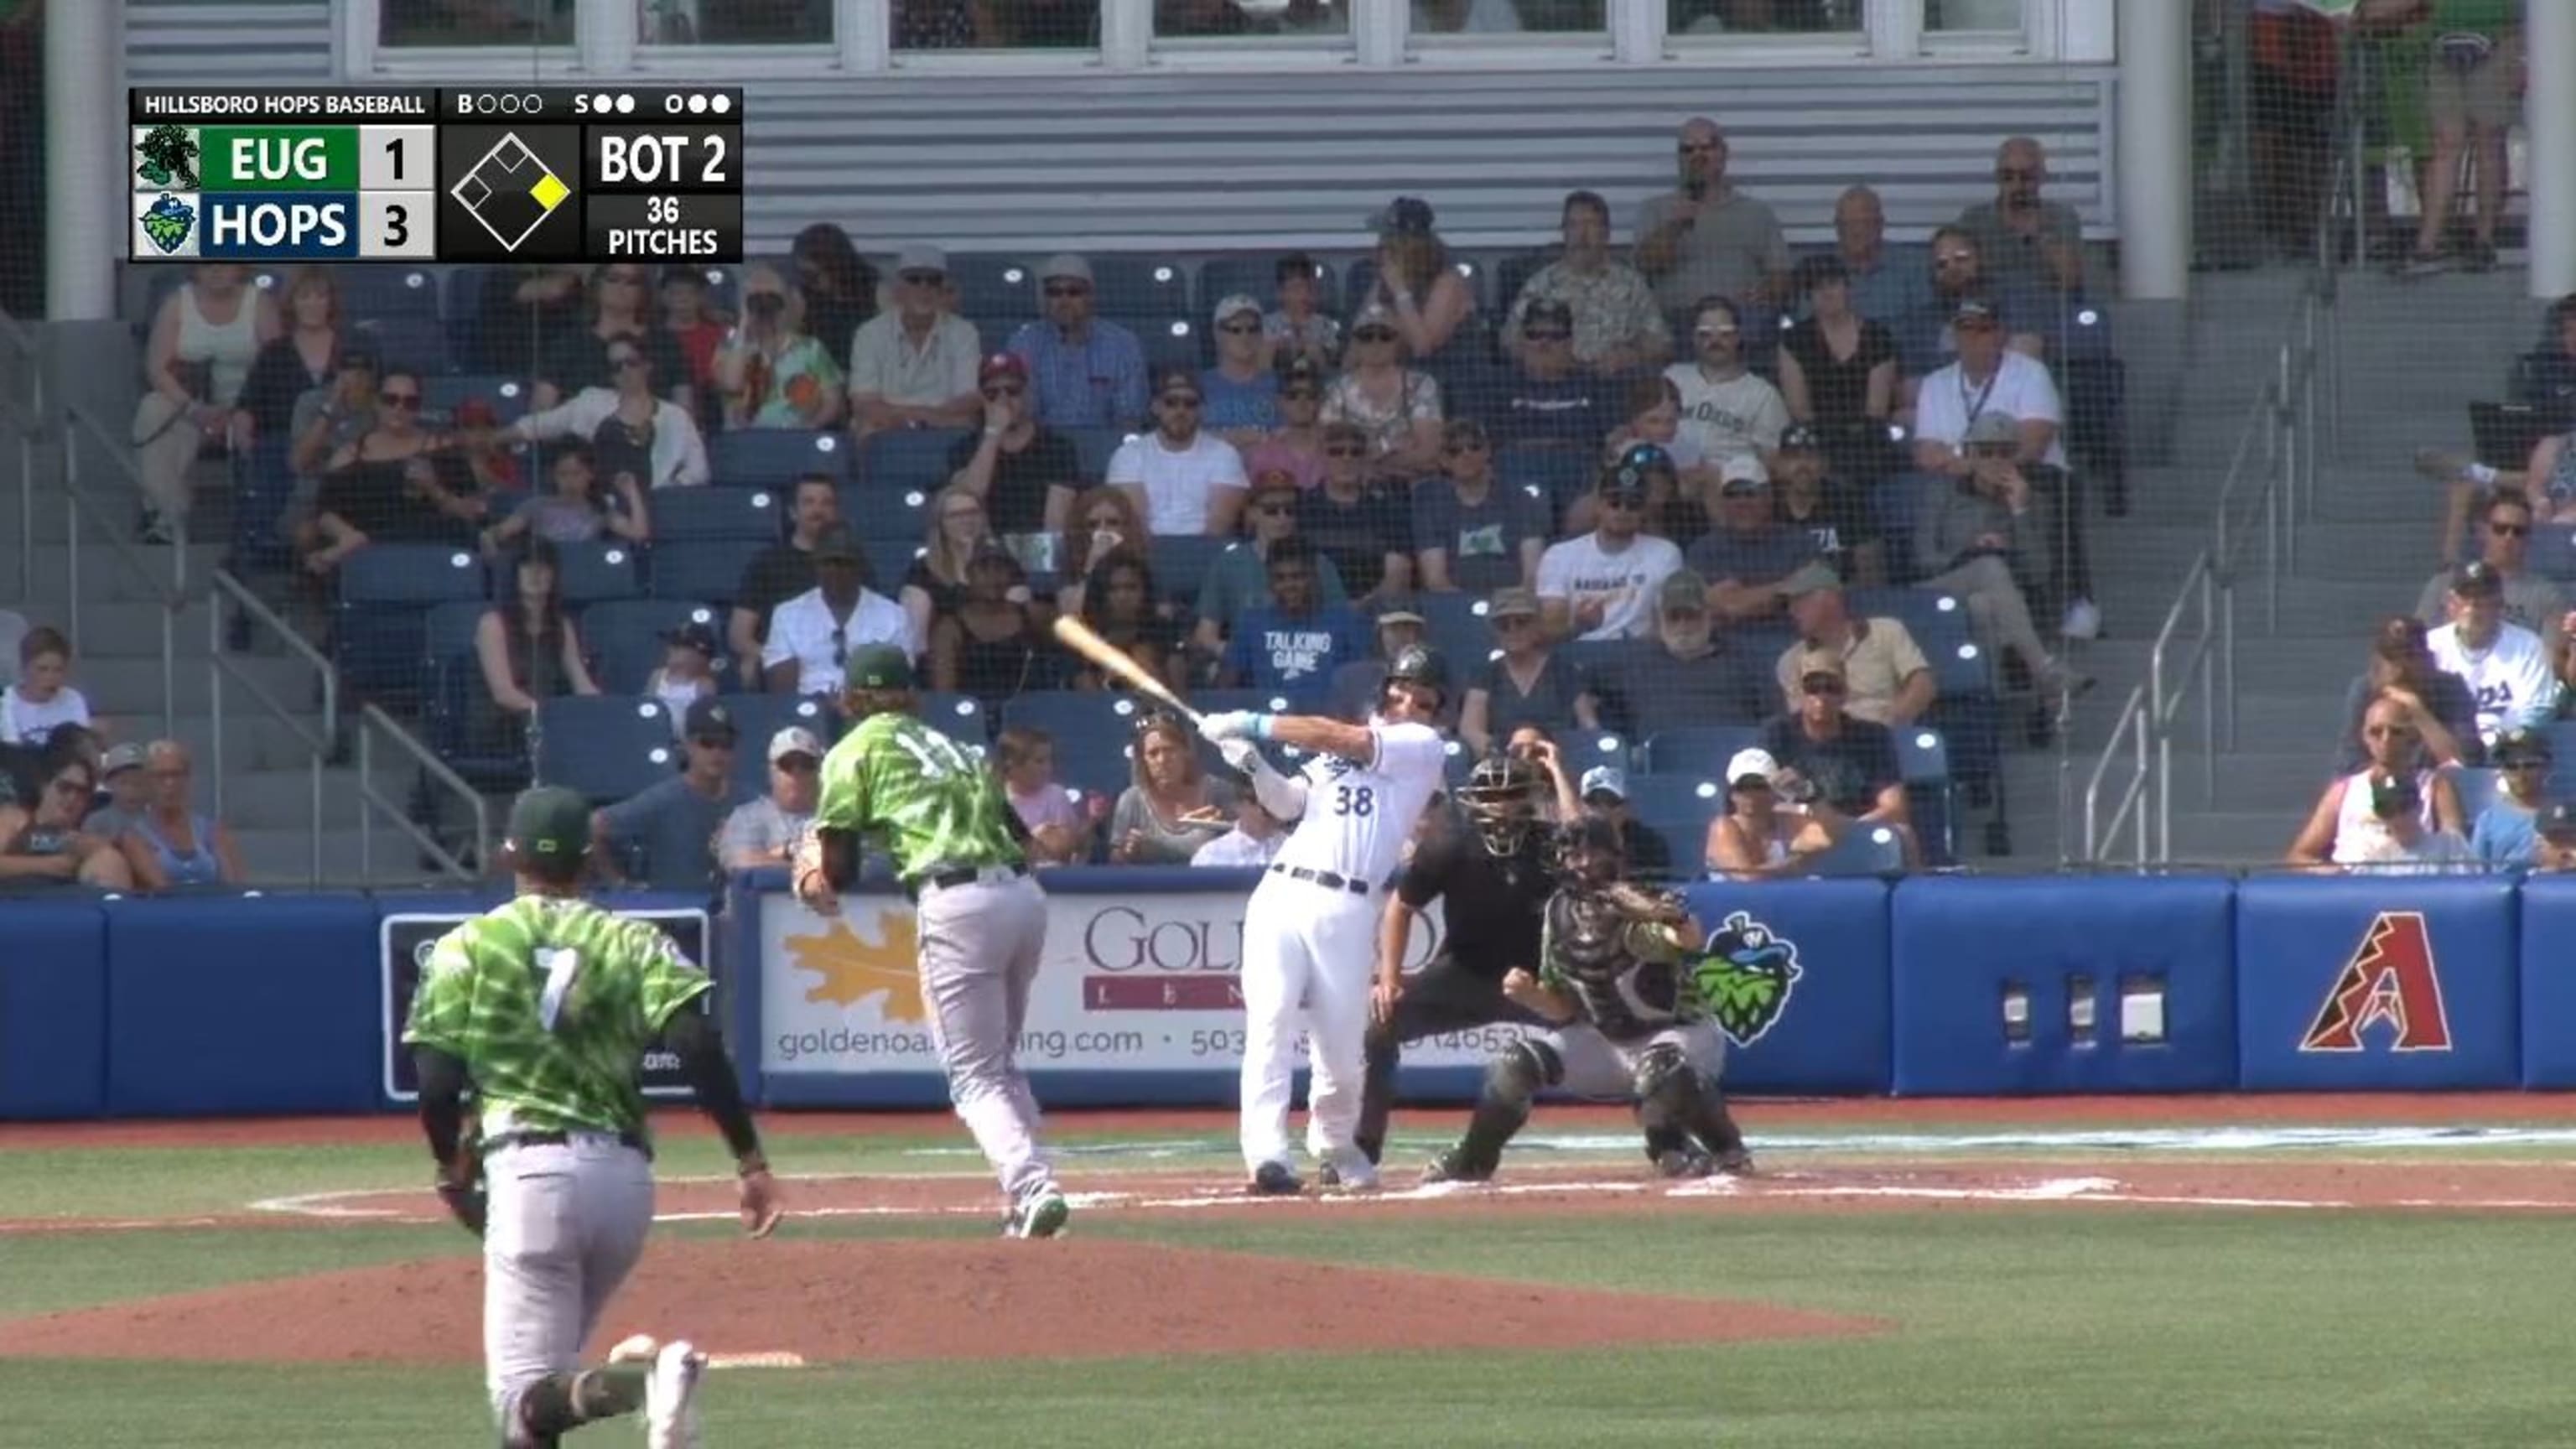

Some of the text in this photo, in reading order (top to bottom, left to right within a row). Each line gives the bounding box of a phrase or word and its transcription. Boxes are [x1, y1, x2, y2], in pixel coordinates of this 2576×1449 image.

[1264, 631, 1332, 653] TALKING
[1273, 649, 1318, 672] GAME
[1334, 786, 1374, 816] 38
[1083, 906, 1244, 972] GOL
[532, 946, 578, 1032] 7
[778, 1028, 1143, 1060] goldenoaing.com
